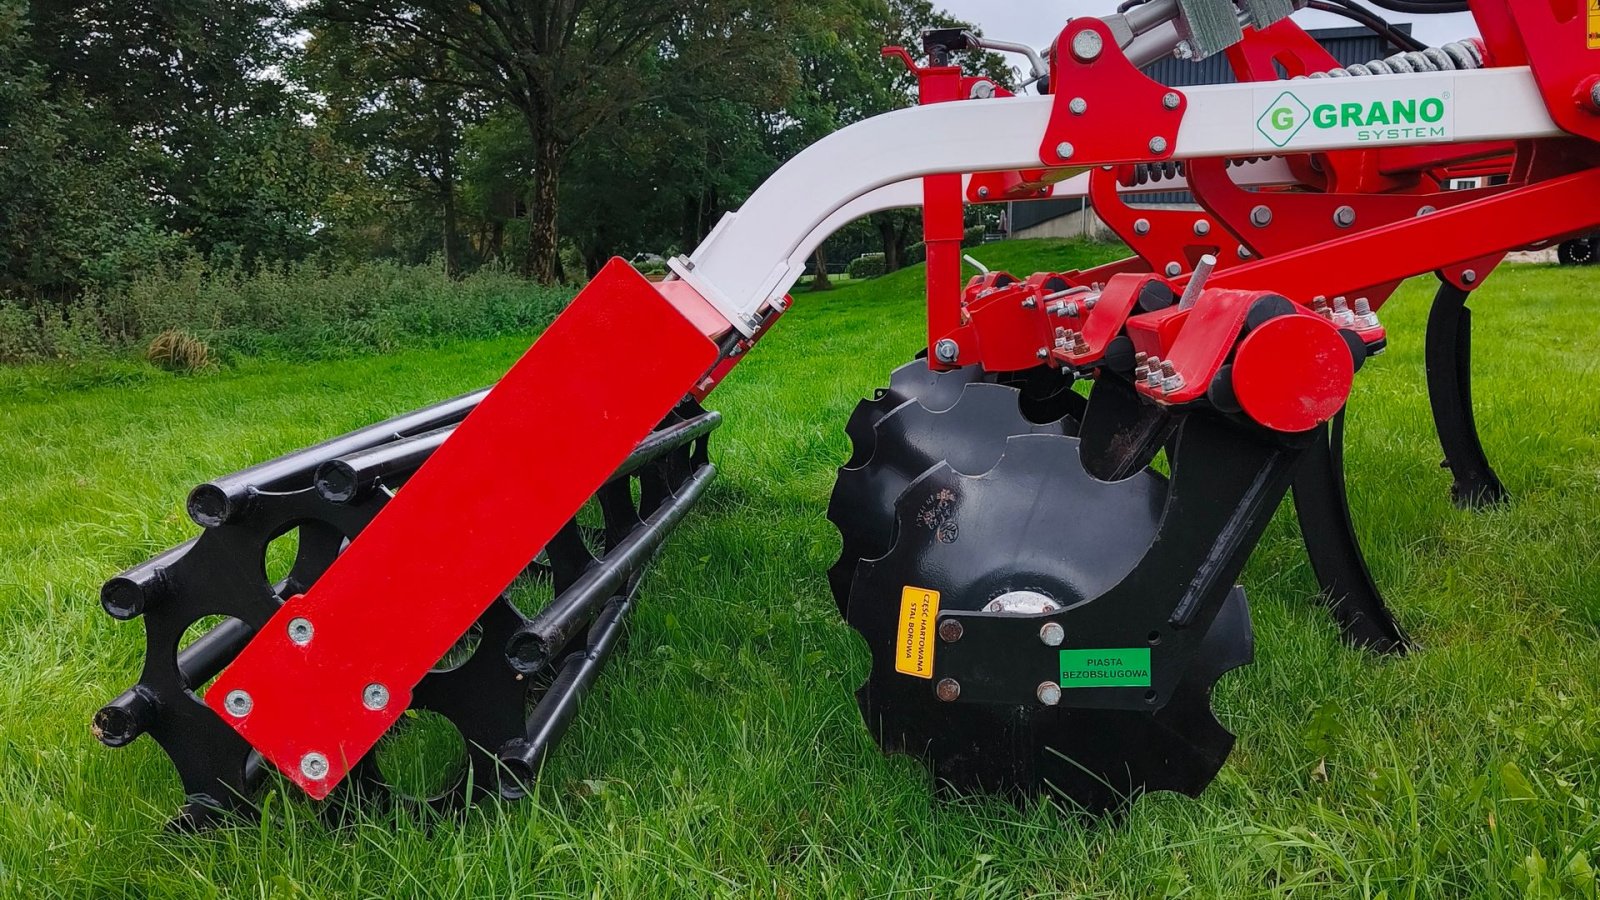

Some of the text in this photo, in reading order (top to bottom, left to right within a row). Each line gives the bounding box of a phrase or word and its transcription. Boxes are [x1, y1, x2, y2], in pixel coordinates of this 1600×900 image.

[1271, 107, 1294, 131] G
[1312, 97, 1445, 129] GRANO
[1357, 127, 1445, 141] SYSTEM
[906, 602, 917, 659] STAL BOROWA
[917, 619, 927, 672] HARTOWANA
[1062, 669, 1148, 679] BEZOBSŁUGOWA
[1087, 658, 1123, 667] PIASTA
